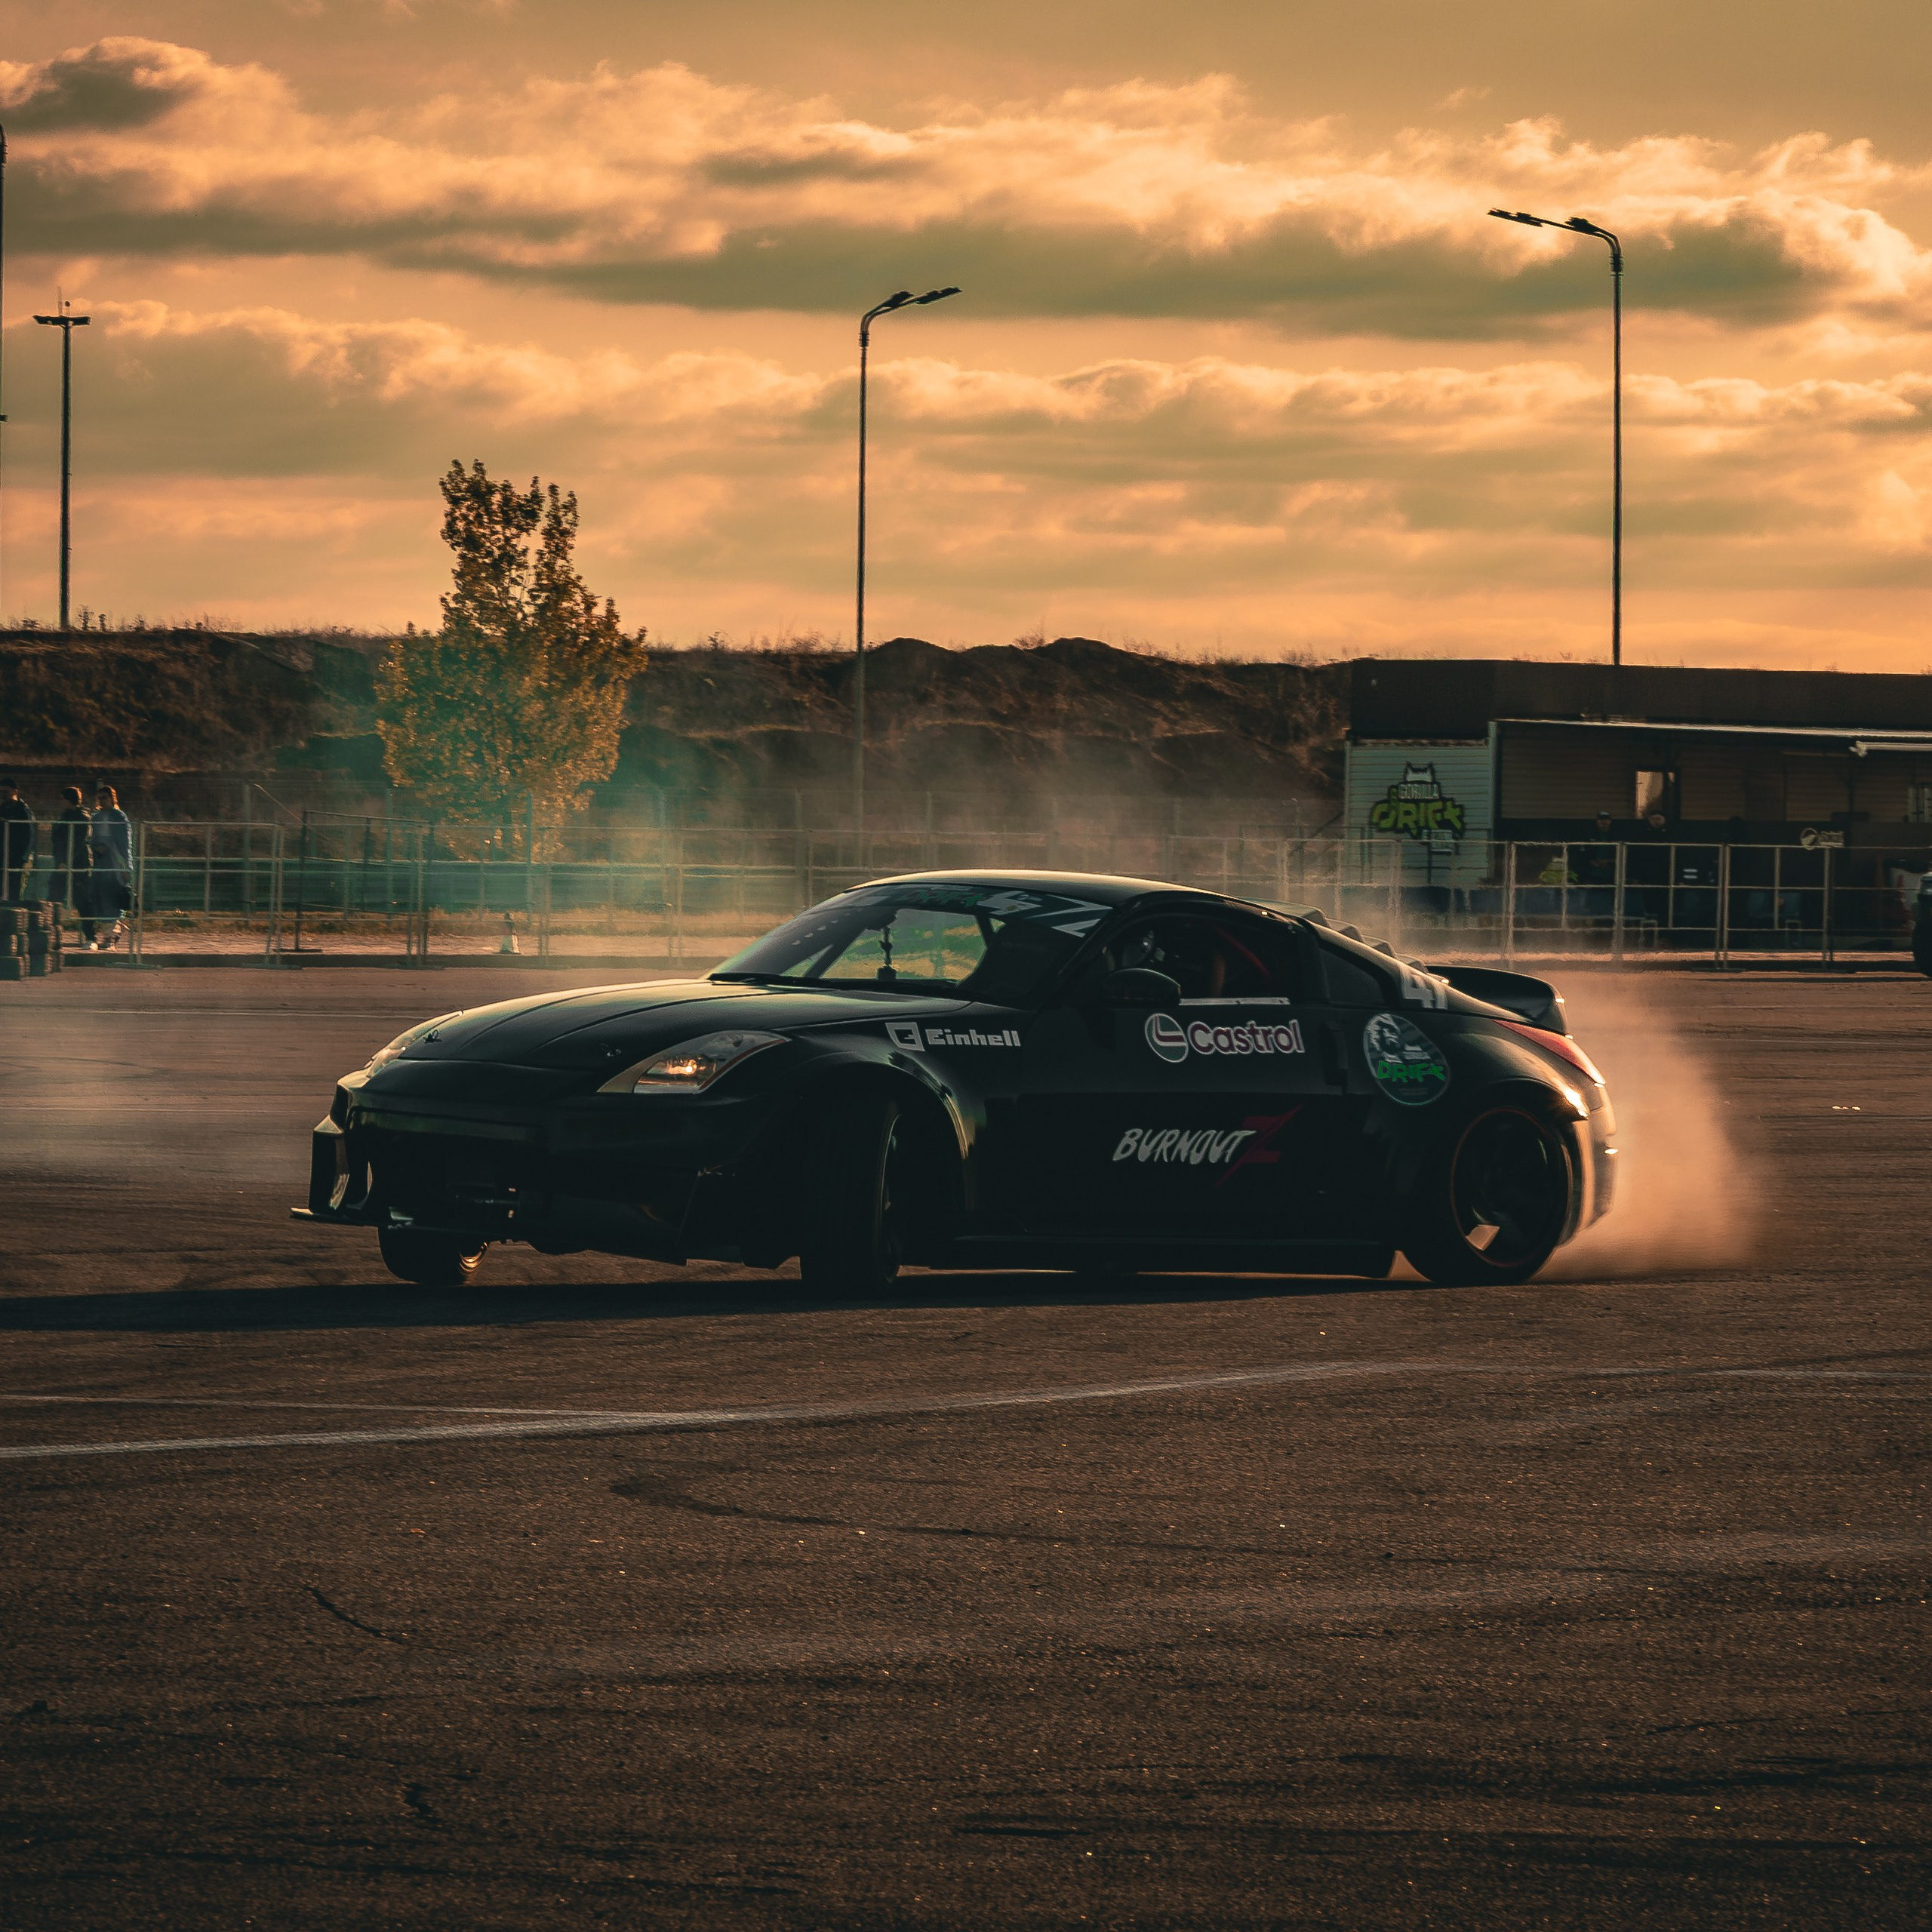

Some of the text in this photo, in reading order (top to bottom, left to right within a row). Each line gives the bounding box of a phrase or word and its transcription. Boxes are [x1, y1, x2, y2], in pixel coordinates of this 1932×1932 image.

[924, 1028, 1021, 1047] Einhell
[1187, 1020, 1306, 1054] Castrol
[1112, 1128, 1257, 1164] BURNOUT
